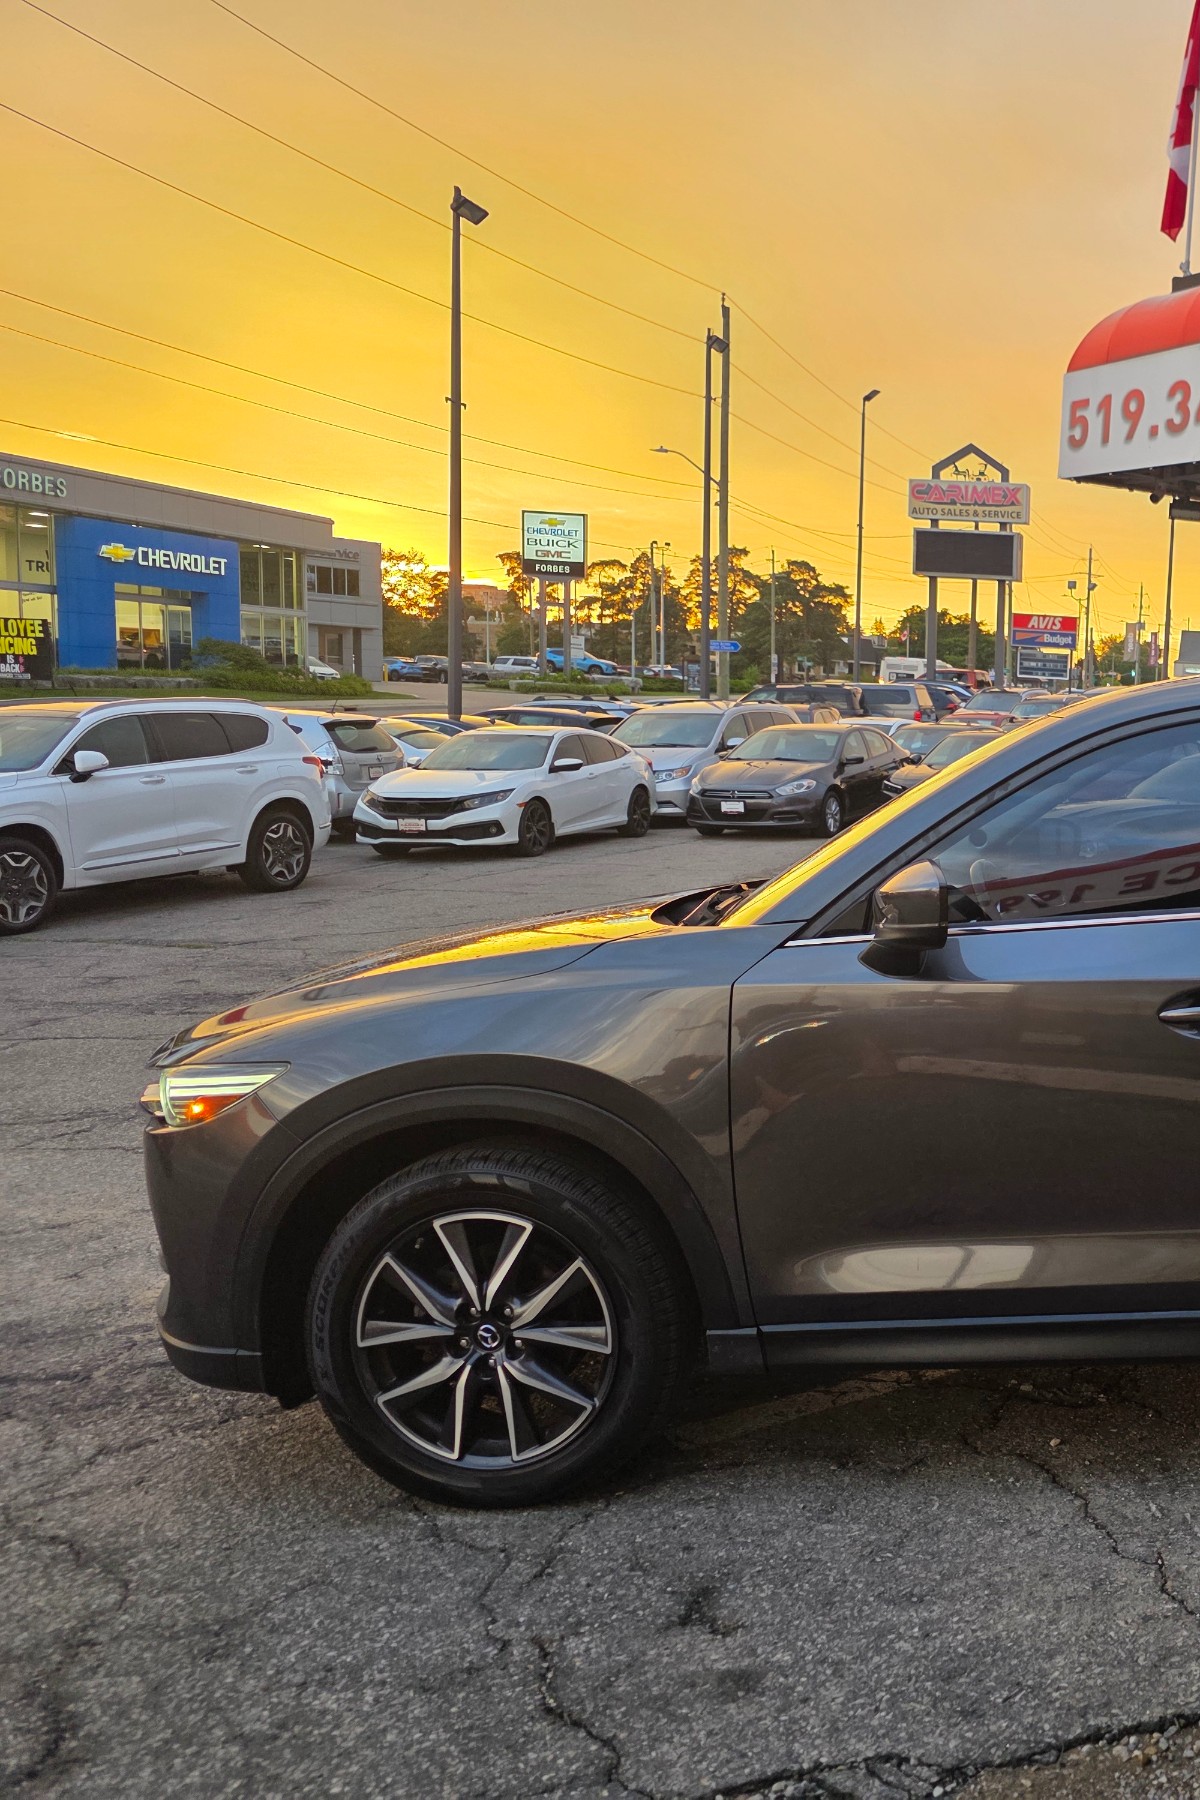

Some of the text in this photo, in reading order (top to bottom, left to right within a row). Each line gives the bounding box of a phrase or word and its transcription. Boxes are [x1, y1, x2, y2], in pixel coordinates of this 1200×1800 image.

[0, 467, 67, 498] ORBES
[911, 483, 1022, 505] CARIMEX
[911, 506, 1022, 520] AUTO SALES & SERVICE
[526, 526, 580, 538] CHEVROLET
[526, 538, 579, 549] BUICK
[138, 546, 228, 576] CHEVROLET
[535, 549, 572, 560] GMC
[535, 563, 571, 574] FORBES
[1028, 616, 1063, 631] AVIS
[0, 636, 38, 656] ICING
[1043, 633, 1073, 646] Budget
[6, 654, 15, 664] IS
[0, 663, 21, 673] BACK
